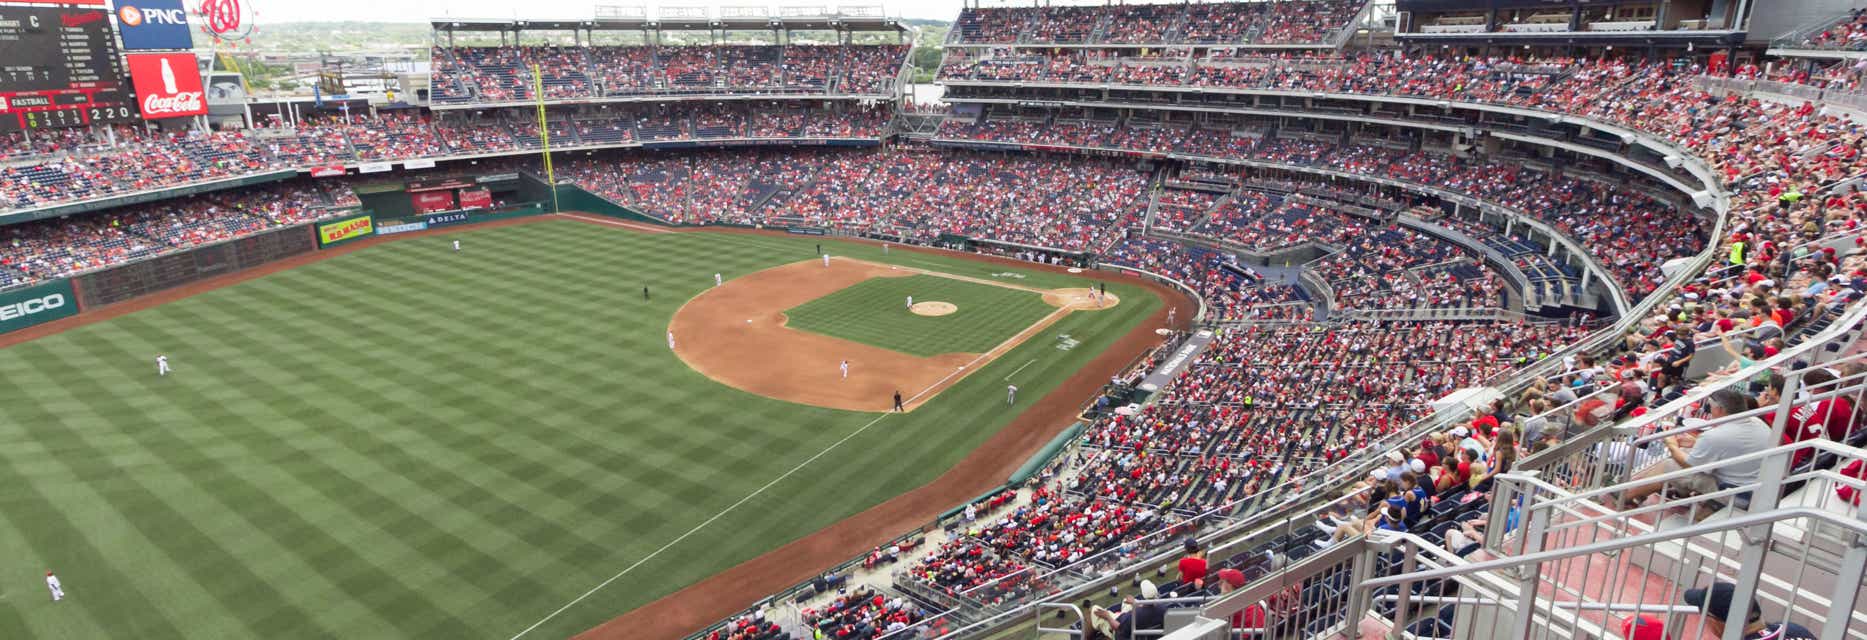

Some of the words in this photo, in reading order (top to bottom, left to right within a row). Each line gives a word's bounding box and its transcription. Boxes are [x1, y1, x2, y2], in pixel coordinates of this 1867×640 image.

[30, 15, 40, 28] C
[141, 8, 188, 25] PNC
[11, 97, 50, 107] FASTBALL
[144, 91, 202, 115] Coca-Cola
[91, 108, 101, 120] 2
[104, 107, 115, 119] 2
[120, 107, 129, 118] 0
[437, 214, 467, 223] DELTA
